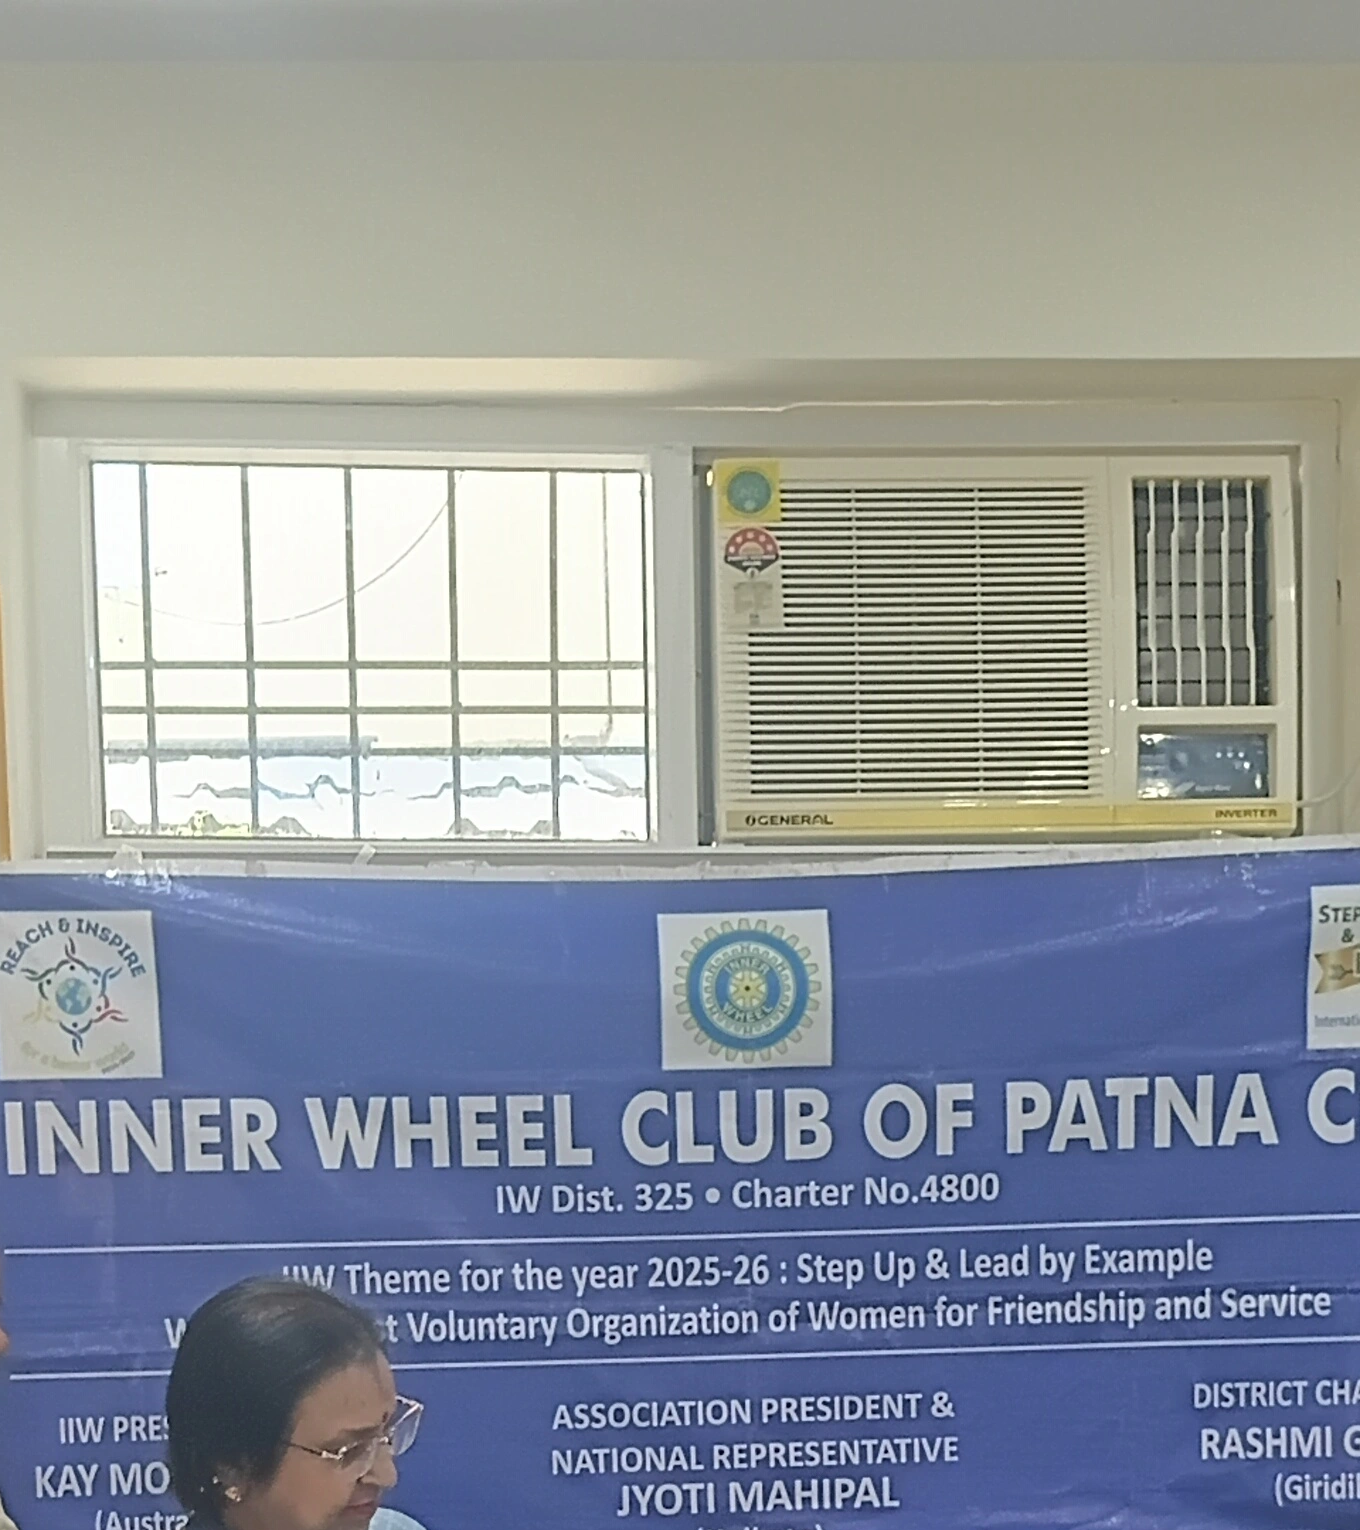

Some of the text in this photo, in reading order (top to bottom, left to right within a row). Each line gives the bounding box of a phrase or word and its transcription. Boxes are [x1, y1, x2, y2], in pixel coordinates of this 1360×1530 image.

[1215, 809, 1277, 818] INVERTER
[0, 917, 147, 978] REACH & INSPIRE
[1341, 927, 1354, 943] &
[724, 957, 771, 975] INNER
[722, 1001, 773, 1023] WHEEL
[4, 1097, 281, 1176] INNER
[304, 1090, 593, 1173] WHEEL
[621, 1085, 834, 1166] CLUB
[863, 1082, 975, 1159] OF
[1006, 1072, 1279, 1155] PATNA
[496, 1173, 1000, 1214] IW Dist. 325 Charter No.4800
[343, 1262, 451, 1295] Theme
[460, 1259, 503, 1292] for
[512, 1259, 563, 1291] the
[572, 1262, 639, 1297] year
[647, 1254, 770, 1288] 2025-26
[797, 1253, 864, 1289] Step
[874, 1251, 916, 1288] Up
[925, 1248, 950, 1280] &
[960, 1245, 1029, 1279] Lead
[1039, 1243, 1074, 1283] by
[1085, 1239, 1213, 1279] Example
[406, 1309, 558, 1347] Voluntary
[566, 1305, 759, 1346] Organization
[768, 1301, 800, 1333] of
[807, 1299, 926, 1332] Women
[934, 1296, 978, 1328] for
[987, 1291, 1145, 1329] Friendship
[1154, 1288, 1211, 1321] and
[1220, 1284, 1331, 1318] Service
[552, 1391, 955, 1430] ASSOCIATION PRESIDENT &
[1193, 1380, 1308, 1409] DISTRICT
[59, 1416, 105, 1444] IIW
[1201, 1425, 1333, 1460] RASHMI
[551, 1436, 959, 1475] NATIONAL REPRESENTATIVE
[35, 1461, 170, 1498] KAY MO
[616, 1476, 900, 1517] JYOTI MAHIPAL
